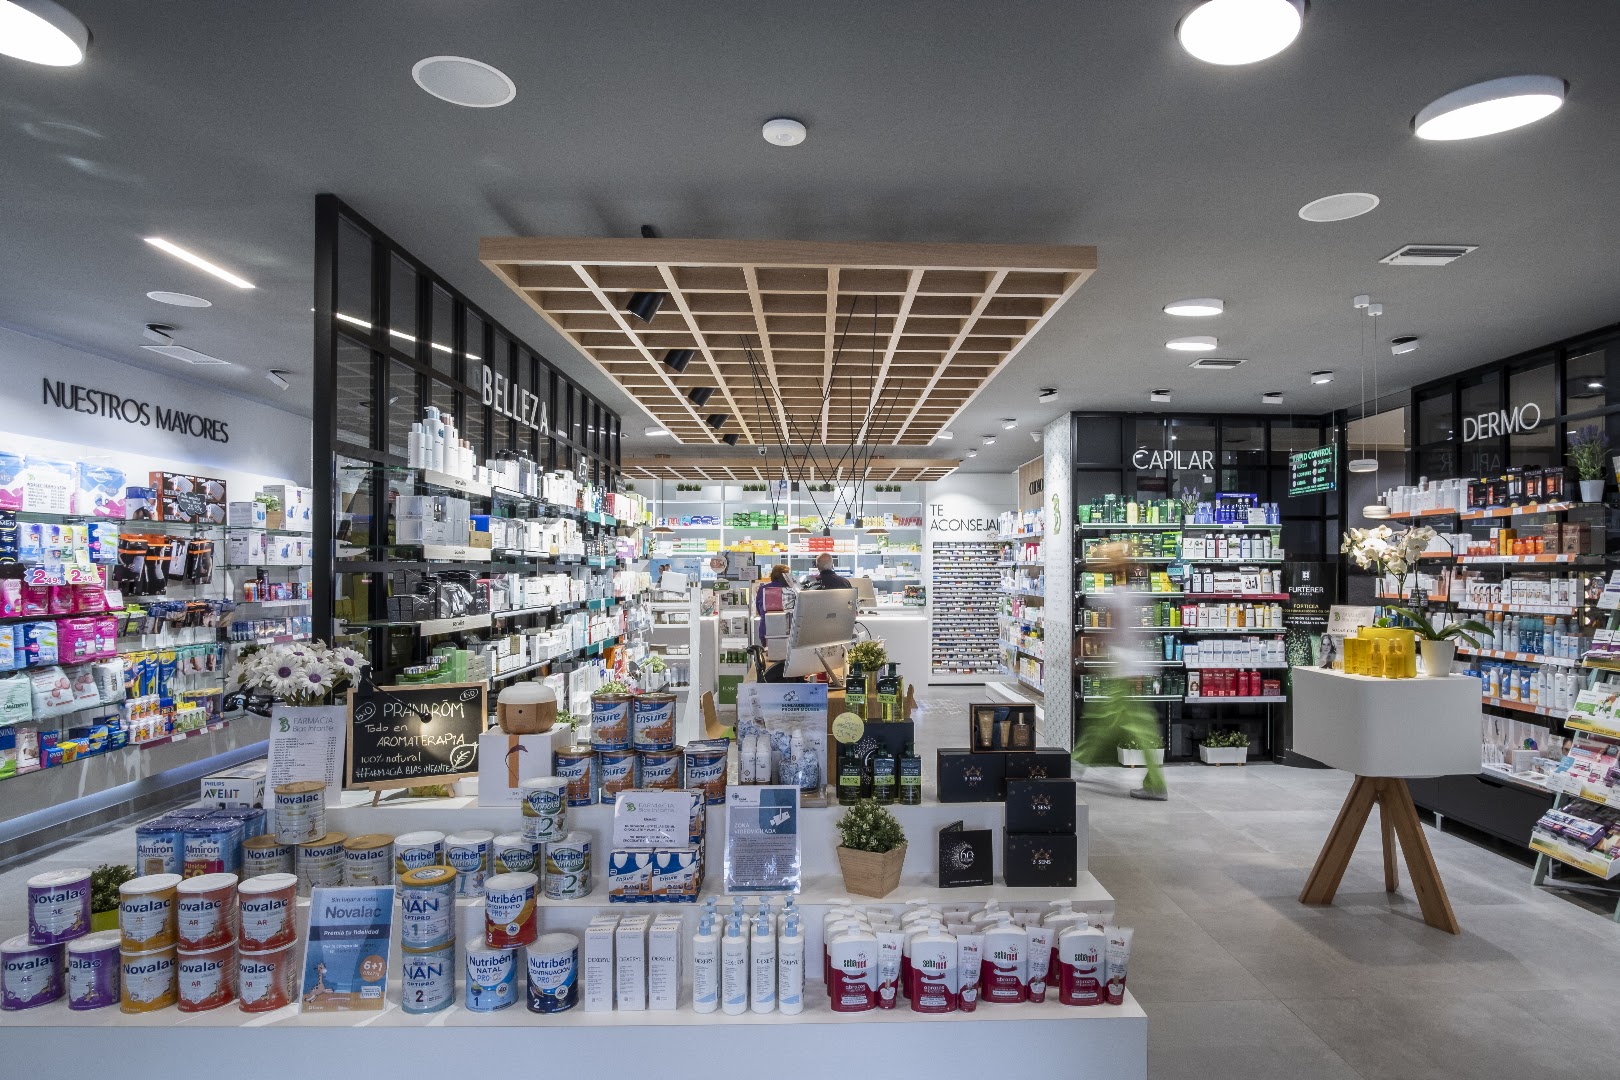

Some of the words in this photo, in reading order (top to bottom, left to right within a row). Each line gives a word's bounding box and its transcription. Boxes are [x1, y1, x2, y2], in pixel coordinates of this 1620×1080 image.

[482, 364, 549, 435] BELLEZA
[43, 378, 151, 427] NUESTROS
[156, 405, 229, 443] MAYORES
[1463, 402, 1541, 443] DERMO
[930, 504, 944, 516] TE
[293, 717, 334, 725] FARMACIA
[636, 712, 669, 724] Ensure
[365, 723, 389, 733] Todo
[394, 724, 408, 732] en
[385, 752, 421, 764] natural
[557, 766, 582, 777] nsure
[601, 766, 627, 777] nsure
[690, 766, 723, 779] Ensure
[204, 789, 240, 799] AVENT
[277, 793, 319, 805] Novalac
[538, 817, 554, 836] 2
[138, 844, 174, 854] Almirón
[185, 844, 220, 854] Almirón
[247, 846, 291, 860] Novalac
[304, 844, 344, 858] Novala
[344, 849, 384, 861] Novalac
[400, 850, 437, 862] Nutribén
[446, 850, 481, 861] Nutribén
[456, 875, 466, 894] 1
[562, 874, 577, 894] 2
[31, 887, 87, 904] Novalac
[485, 890, 523, 904] Nutribén
[119, 899, 171, 913] Novalac
[240, 898, 288, 912] Novalac
[402, 897, 440, 914] NAN
[325, 905, 382, 919] Novalac
[30, 926, 36, 937] 2
[411, 923, 419, 937] 1
[487, 932, 493, 943] 3
[469, 954, 512, 968] Nutribén
[993, 951, 1018, 962] sebamed
[1074, 953, 1098, 963] sebamed
[124, 957, 177, 975] Novalac
[240, 963, 275, 975] ovalac
[529, 957, 572, 969] Nutribén
[843, 959, 867, 969] sebamed
[922, 959, 947, 970] sebamed
[402, 963, 442, 980] NAN
[191, 980, 202, 988] AR
[415, 989, 424, 1003] 2
[473, 996, 479, 1007] 1
[533, 998, 541, 1009] 2
